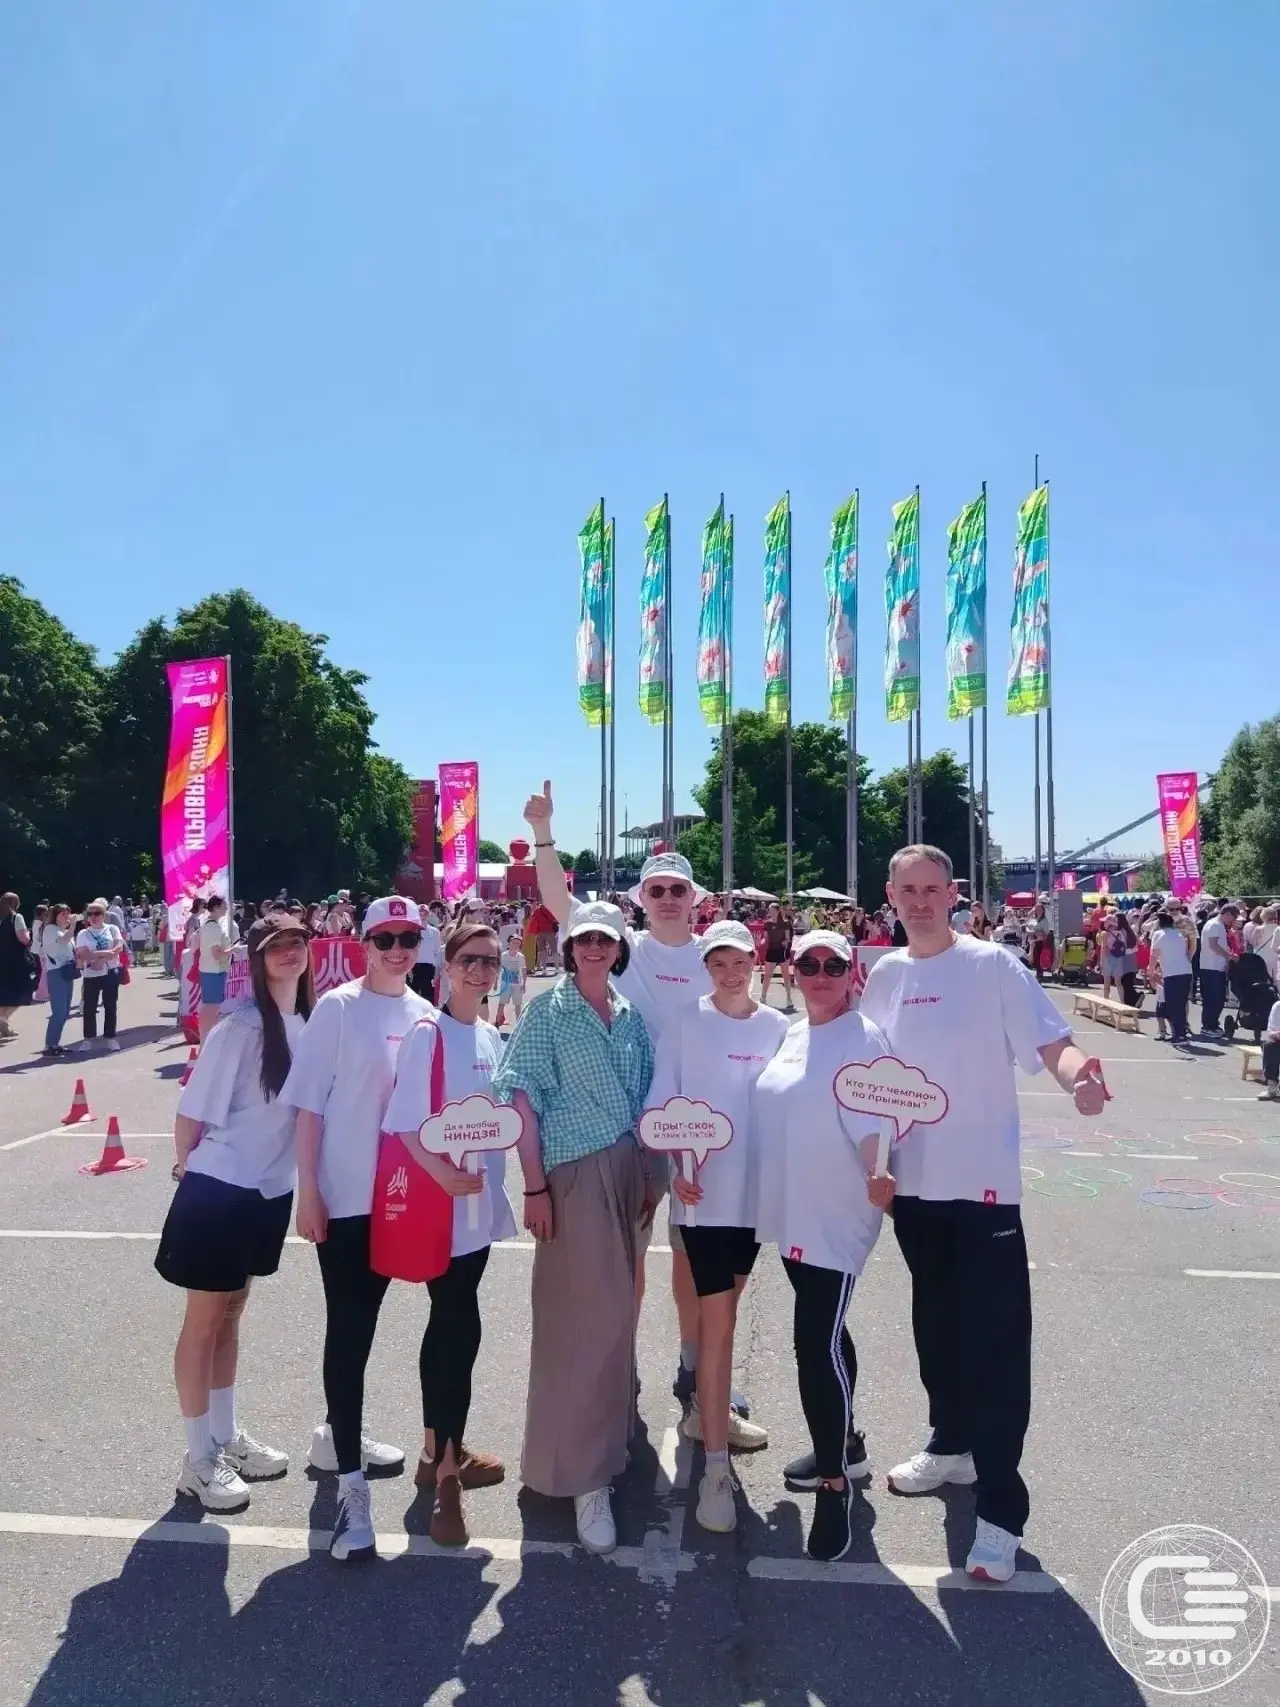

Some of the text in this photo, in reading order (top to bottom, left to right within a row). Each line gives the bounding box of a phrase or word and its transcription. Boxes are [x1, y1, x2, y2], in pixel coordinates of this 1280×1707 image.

[846, 1078, 936, 1101] Кто тут чемпион
[852, 1090, 927, 1108] по прыжкам?
[466, 1121, 499, 1129] вообще
[654, 1121, 715, 1132] Прыг-скок
